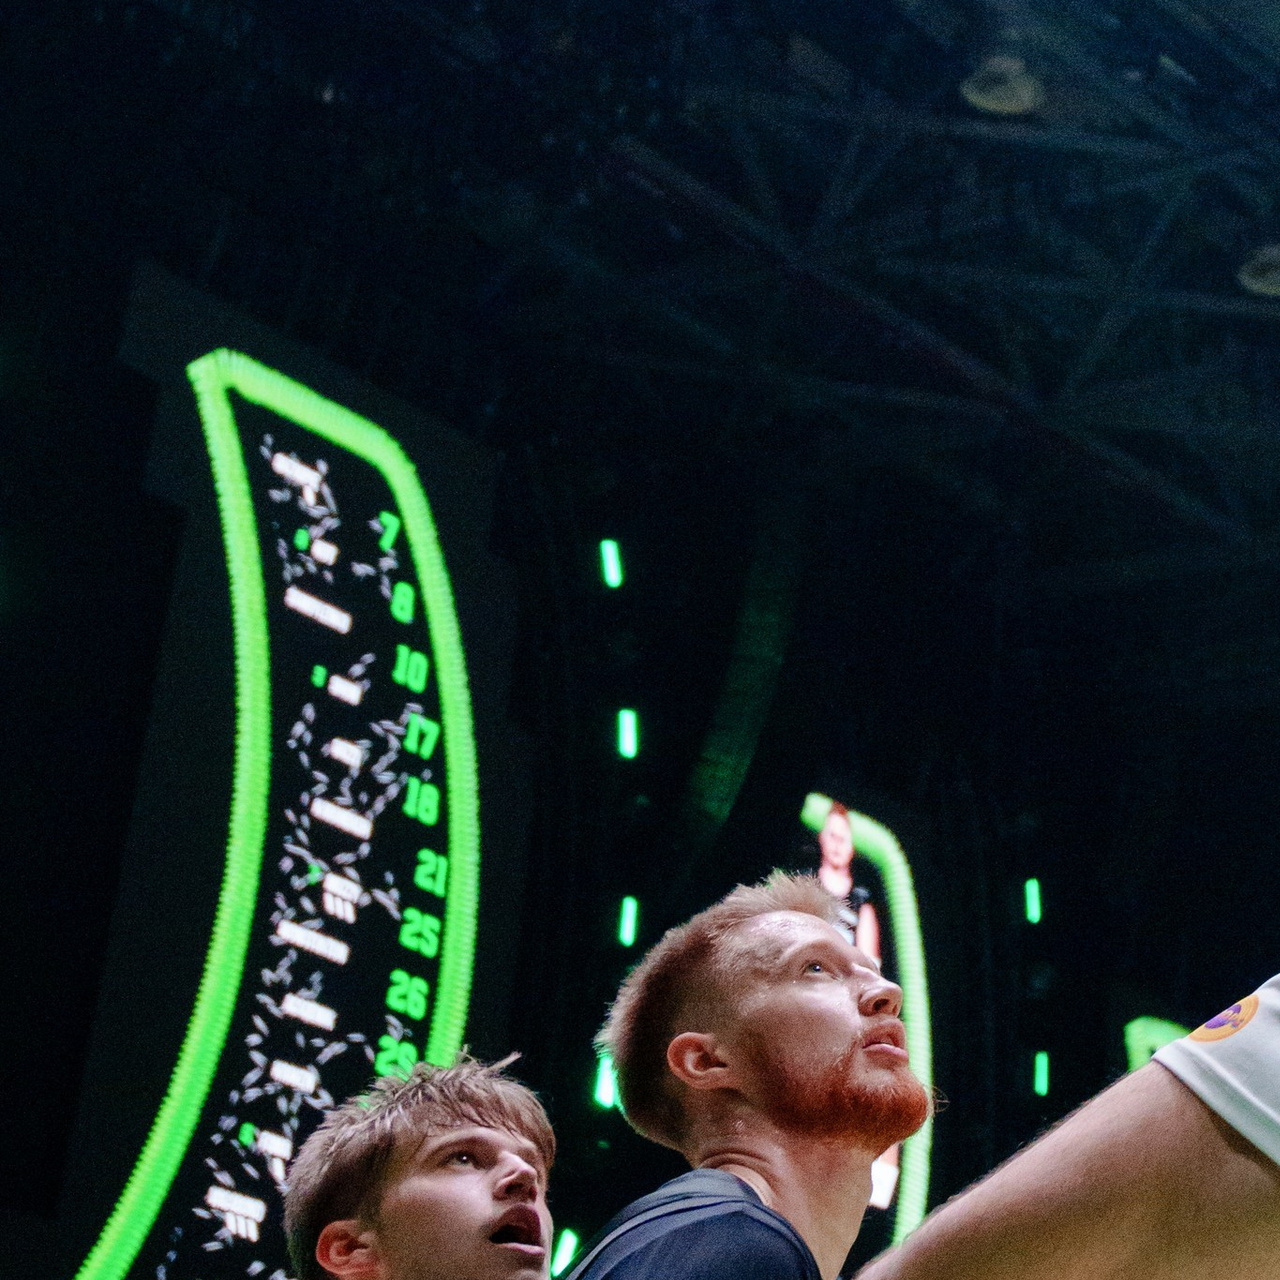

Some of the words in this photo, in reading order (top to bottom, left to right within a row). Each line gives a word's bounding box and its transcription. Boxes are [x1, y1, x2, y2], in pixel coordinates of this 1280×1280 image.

[378, 510, 401, 553] 7
[392, 643, 430, 694] 10
[403, 713, 441, 761] 17
[402, 776, 441, 827] 18
[413, 847, 449, 899] 21
[398, 906, 442, 960] 25
[385, 968, 430, 1021] 26
